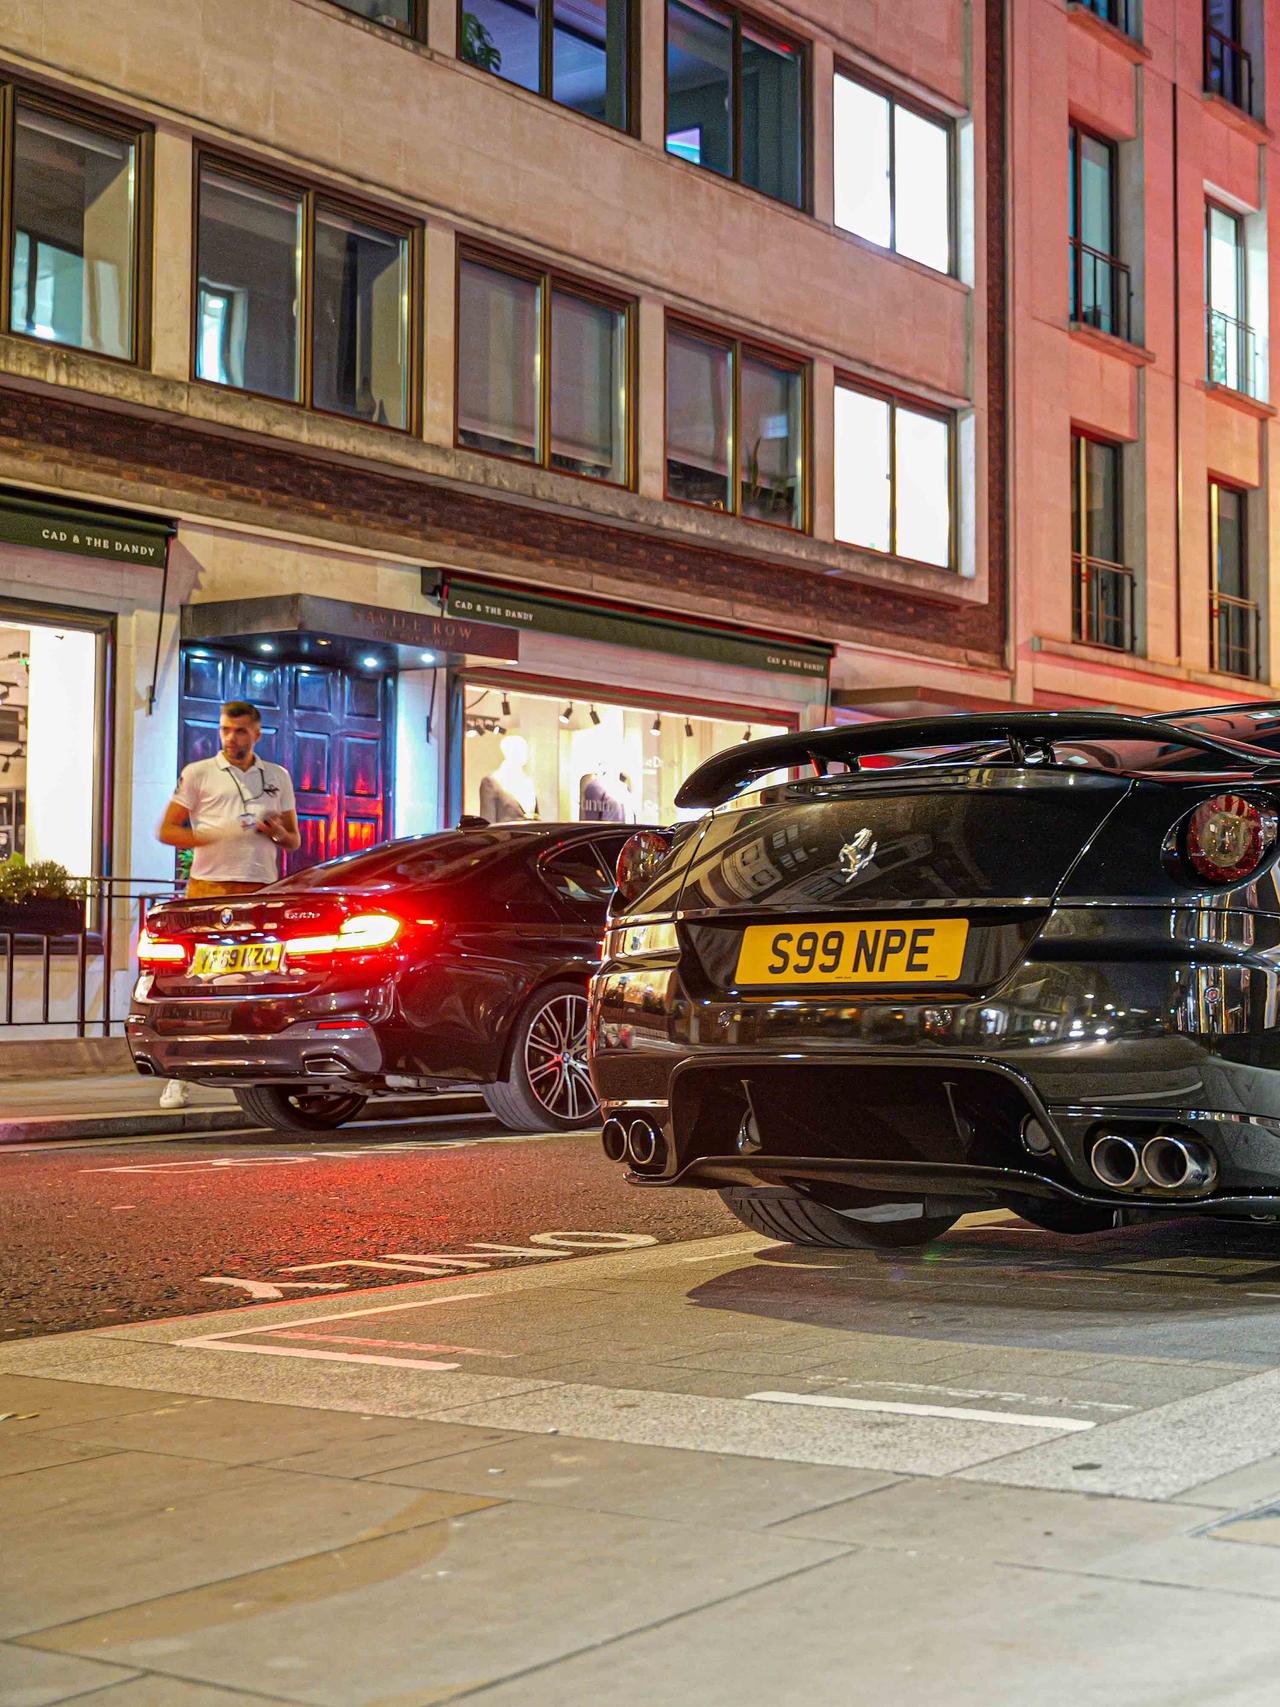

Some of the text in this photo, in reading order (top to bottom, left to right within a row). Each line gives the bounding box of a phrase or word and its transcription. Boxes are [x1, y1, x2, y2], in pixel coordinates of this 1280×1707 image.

[42, 529, 155, 557] CAD & THE DANDY
[354, 610, 472, 639] SAVILE ROW
[454, 600, 534, 622] CAD & THE DANDY
[766, 656, 780, 665] CAD
[788, 659, 801, 668] THE
[803, 662, 824, 672] DANDY
[768, 928, 935, 974] S99 NPE
